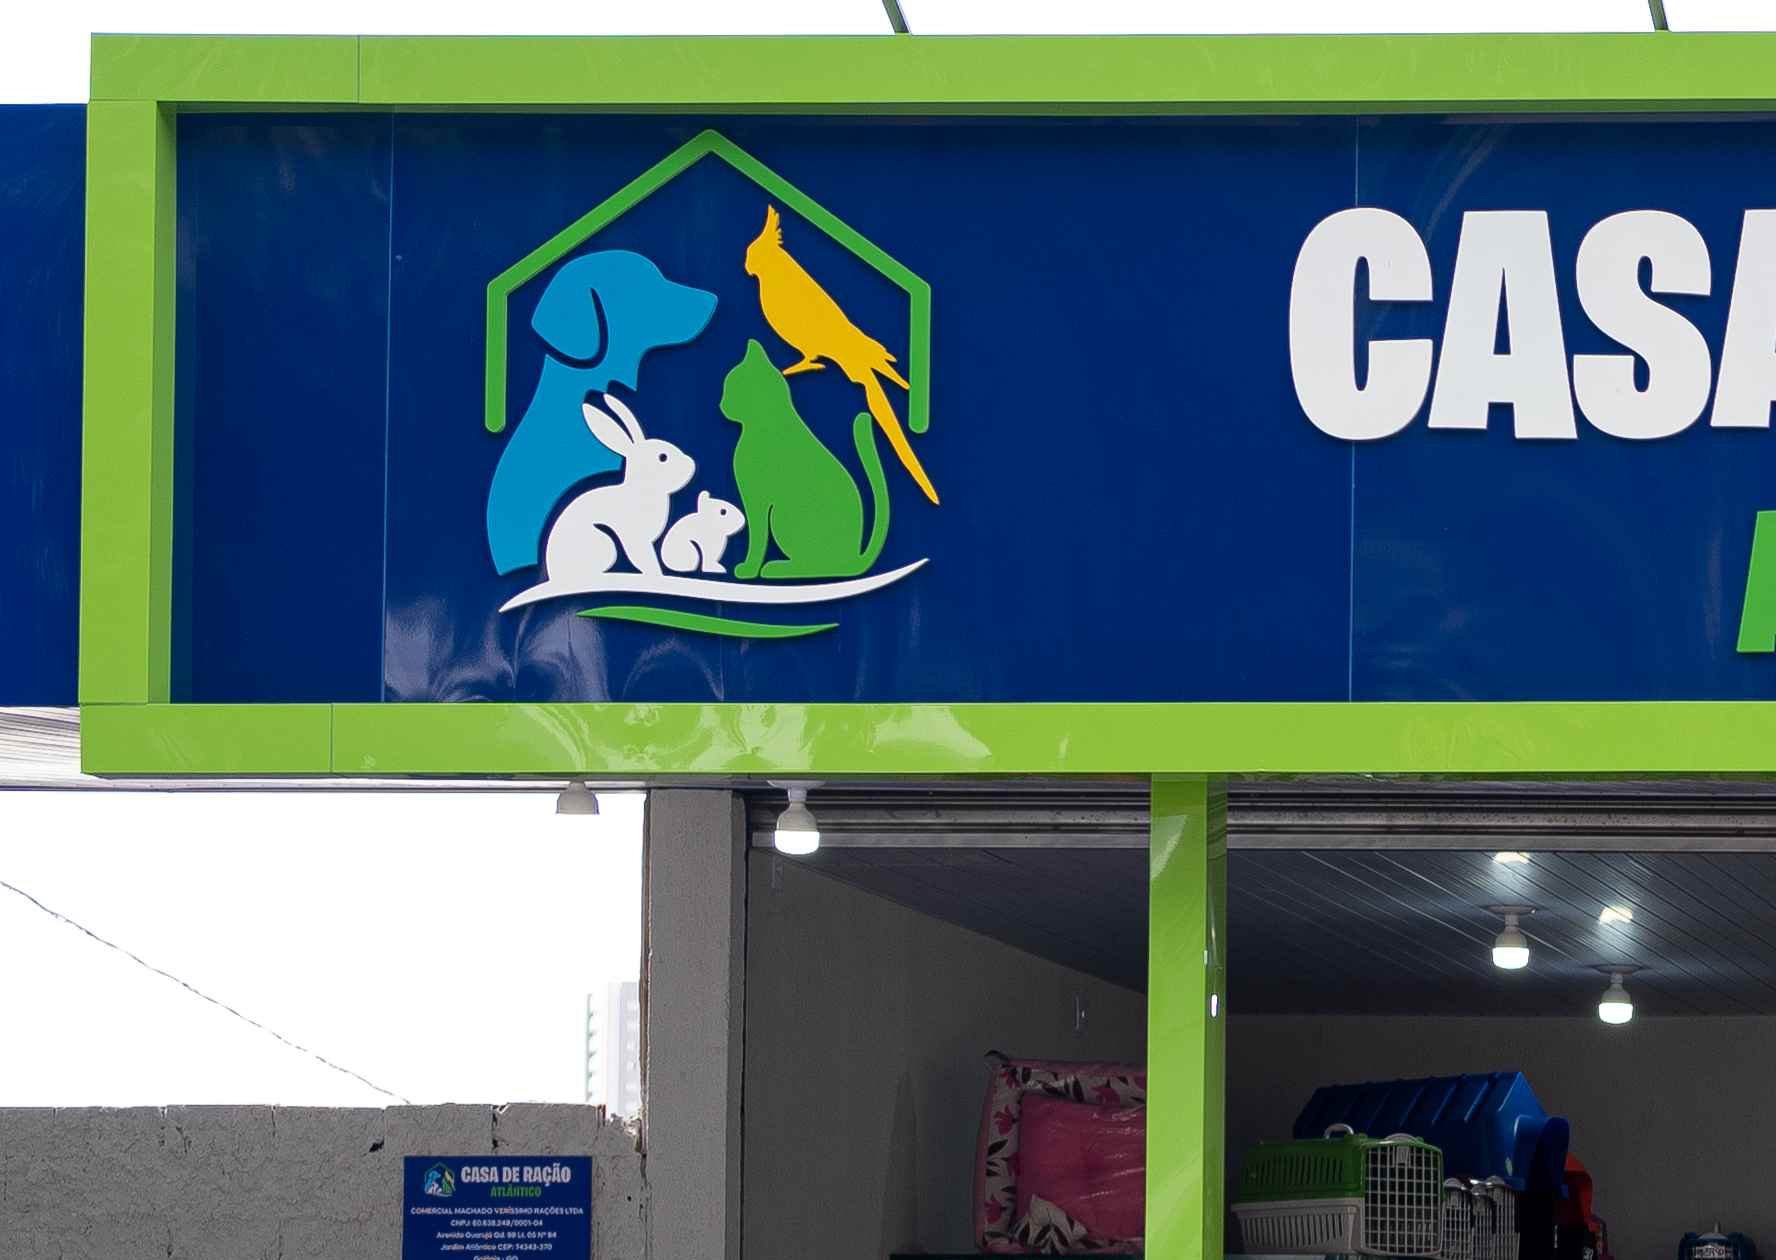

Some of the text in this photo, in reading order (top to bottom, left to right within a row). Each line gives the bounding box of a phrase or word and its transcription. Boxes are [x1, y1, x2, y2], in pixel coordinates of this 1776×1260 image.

[460, 1162, 572, 1188] CASA DE RAÇÃO
